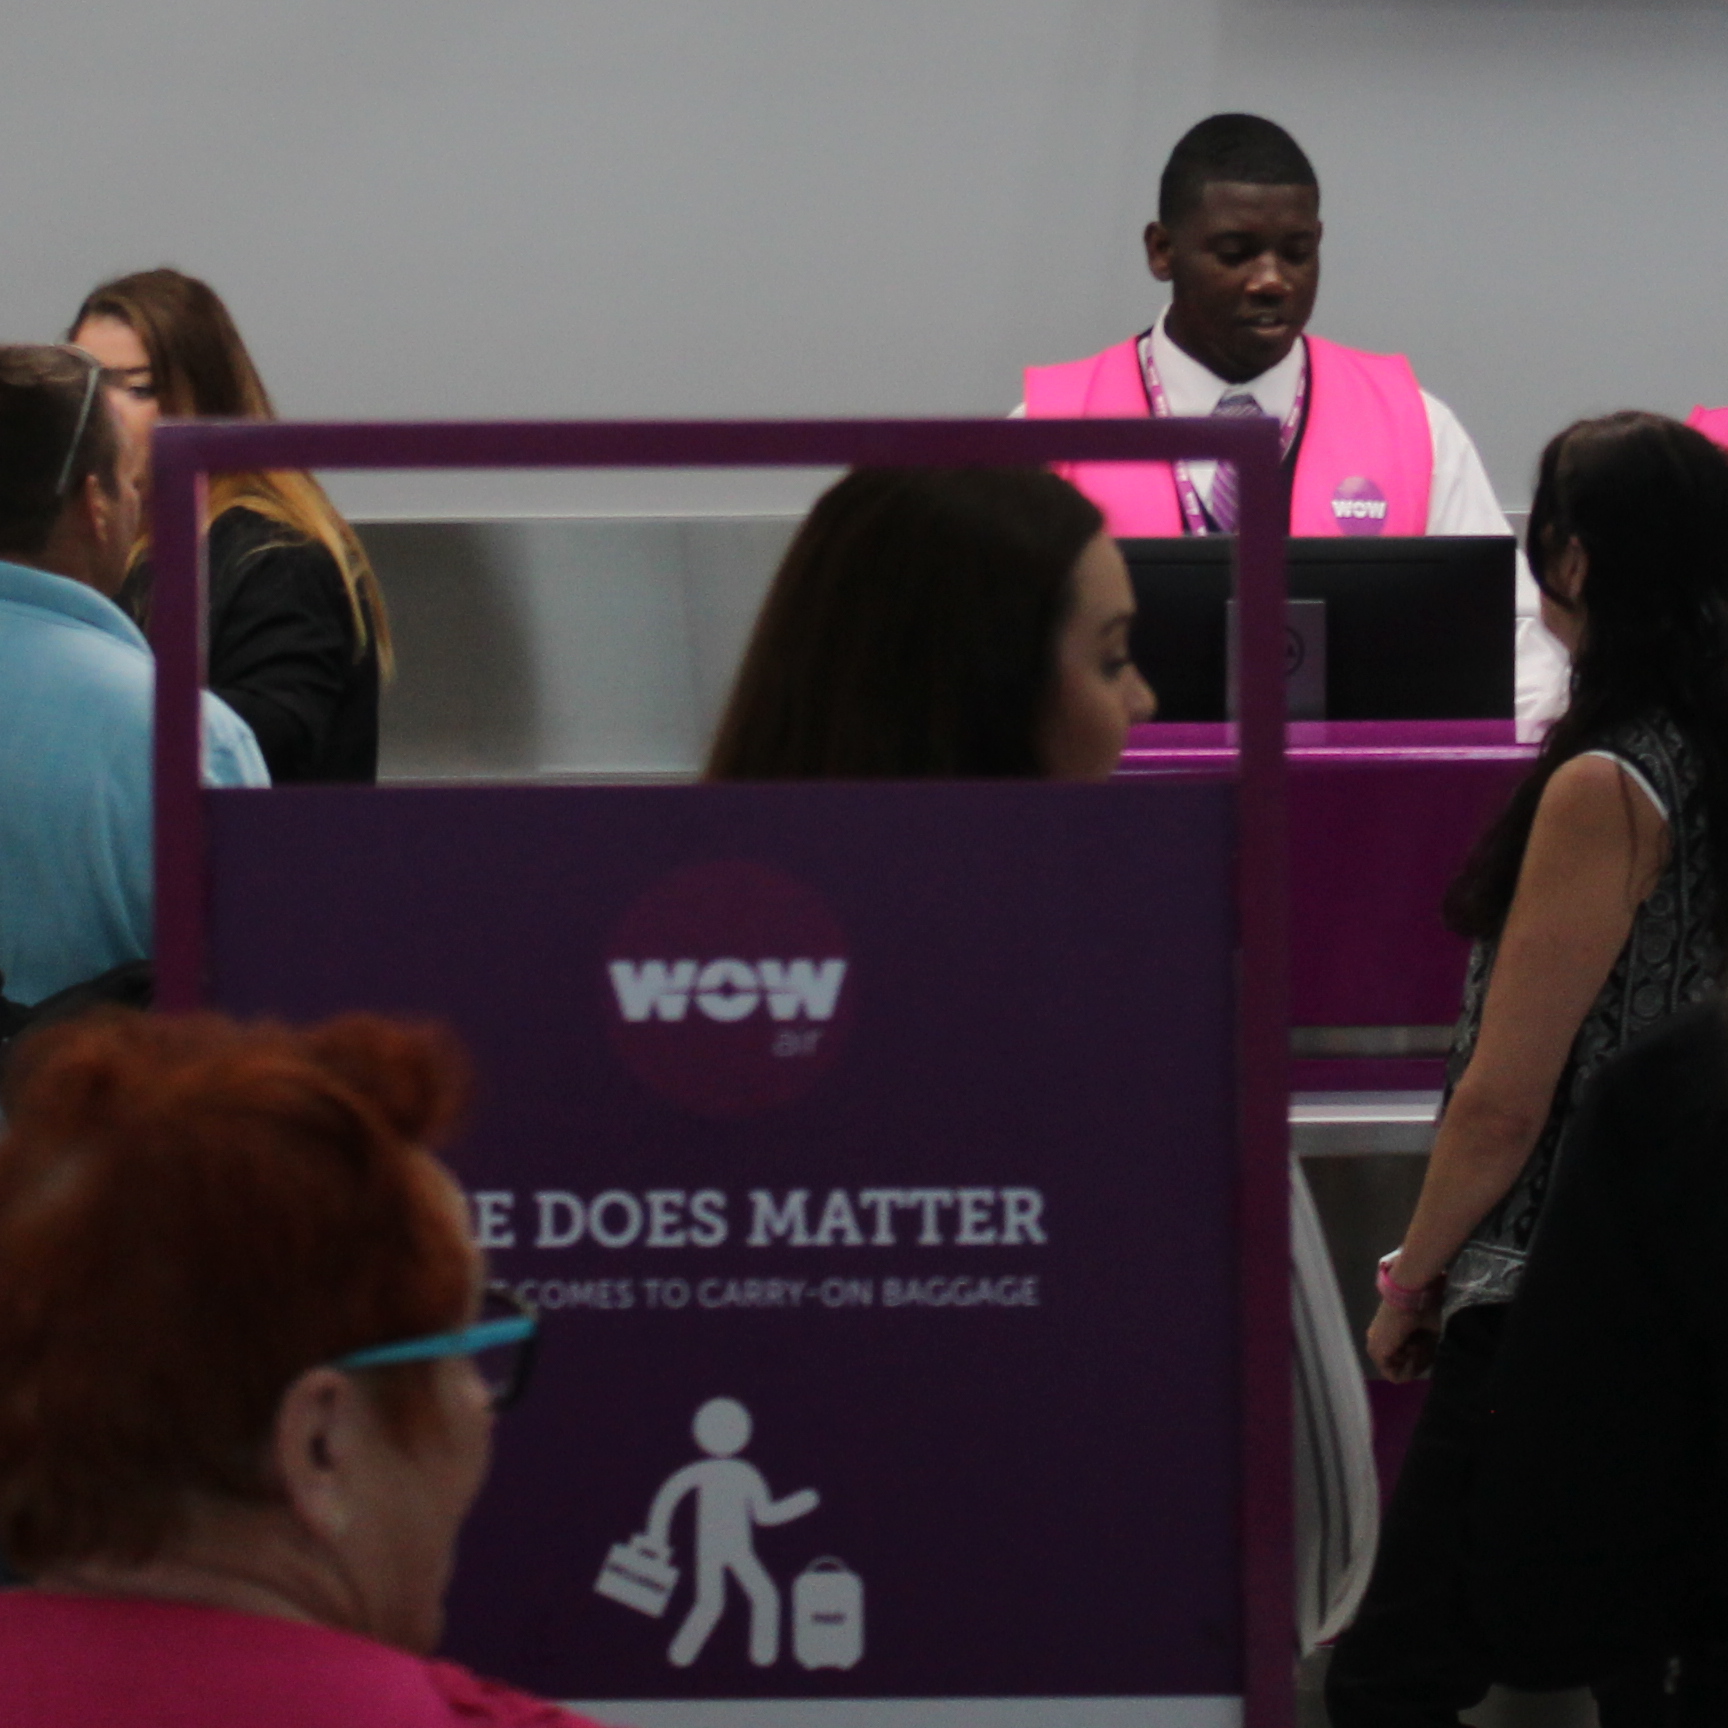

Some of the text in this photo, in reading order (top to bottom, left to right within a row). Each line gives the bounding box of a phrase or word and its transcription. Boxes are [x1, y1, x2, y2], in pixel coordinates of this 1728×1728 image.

[1332, 499, 1387, 519] WOW
[608, 957, 848, 1022] WOW
[534, 1189, 728, 1248] DOES
[746, 1187, 1048, 1247] MATTER
[642, 1278, 691, 1309] TO
[697, 1276, 872, 1308] CARRY-ON
[881, 1275, 1040, 1307] BAGGAGE
